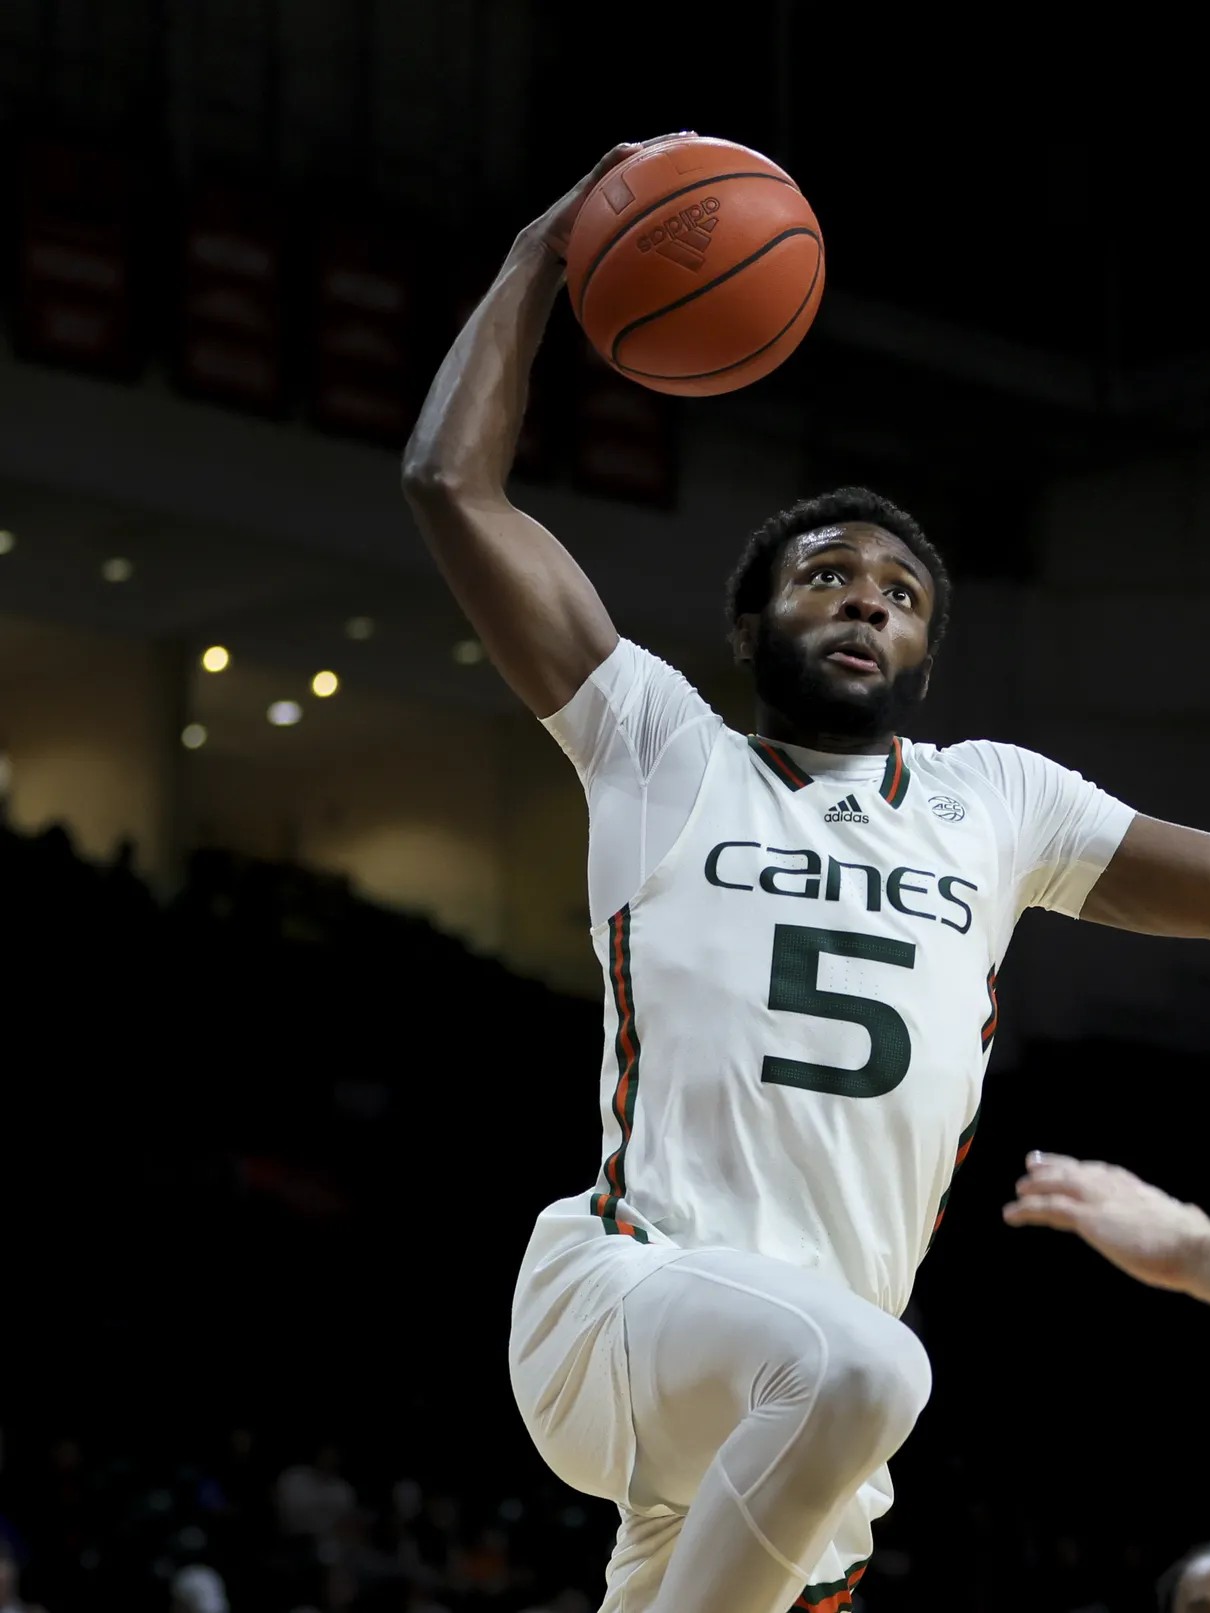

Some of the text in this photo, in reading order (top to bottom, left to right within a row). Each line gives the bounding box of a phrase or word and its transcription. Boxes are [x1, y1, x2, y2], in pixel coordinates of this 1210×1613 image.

[636, 196, 721, 253] adidas
[823, 811, 870, 824] adidas
[931, 803, 962, 812] ACC
[760, 923, 917, 1099] 5
